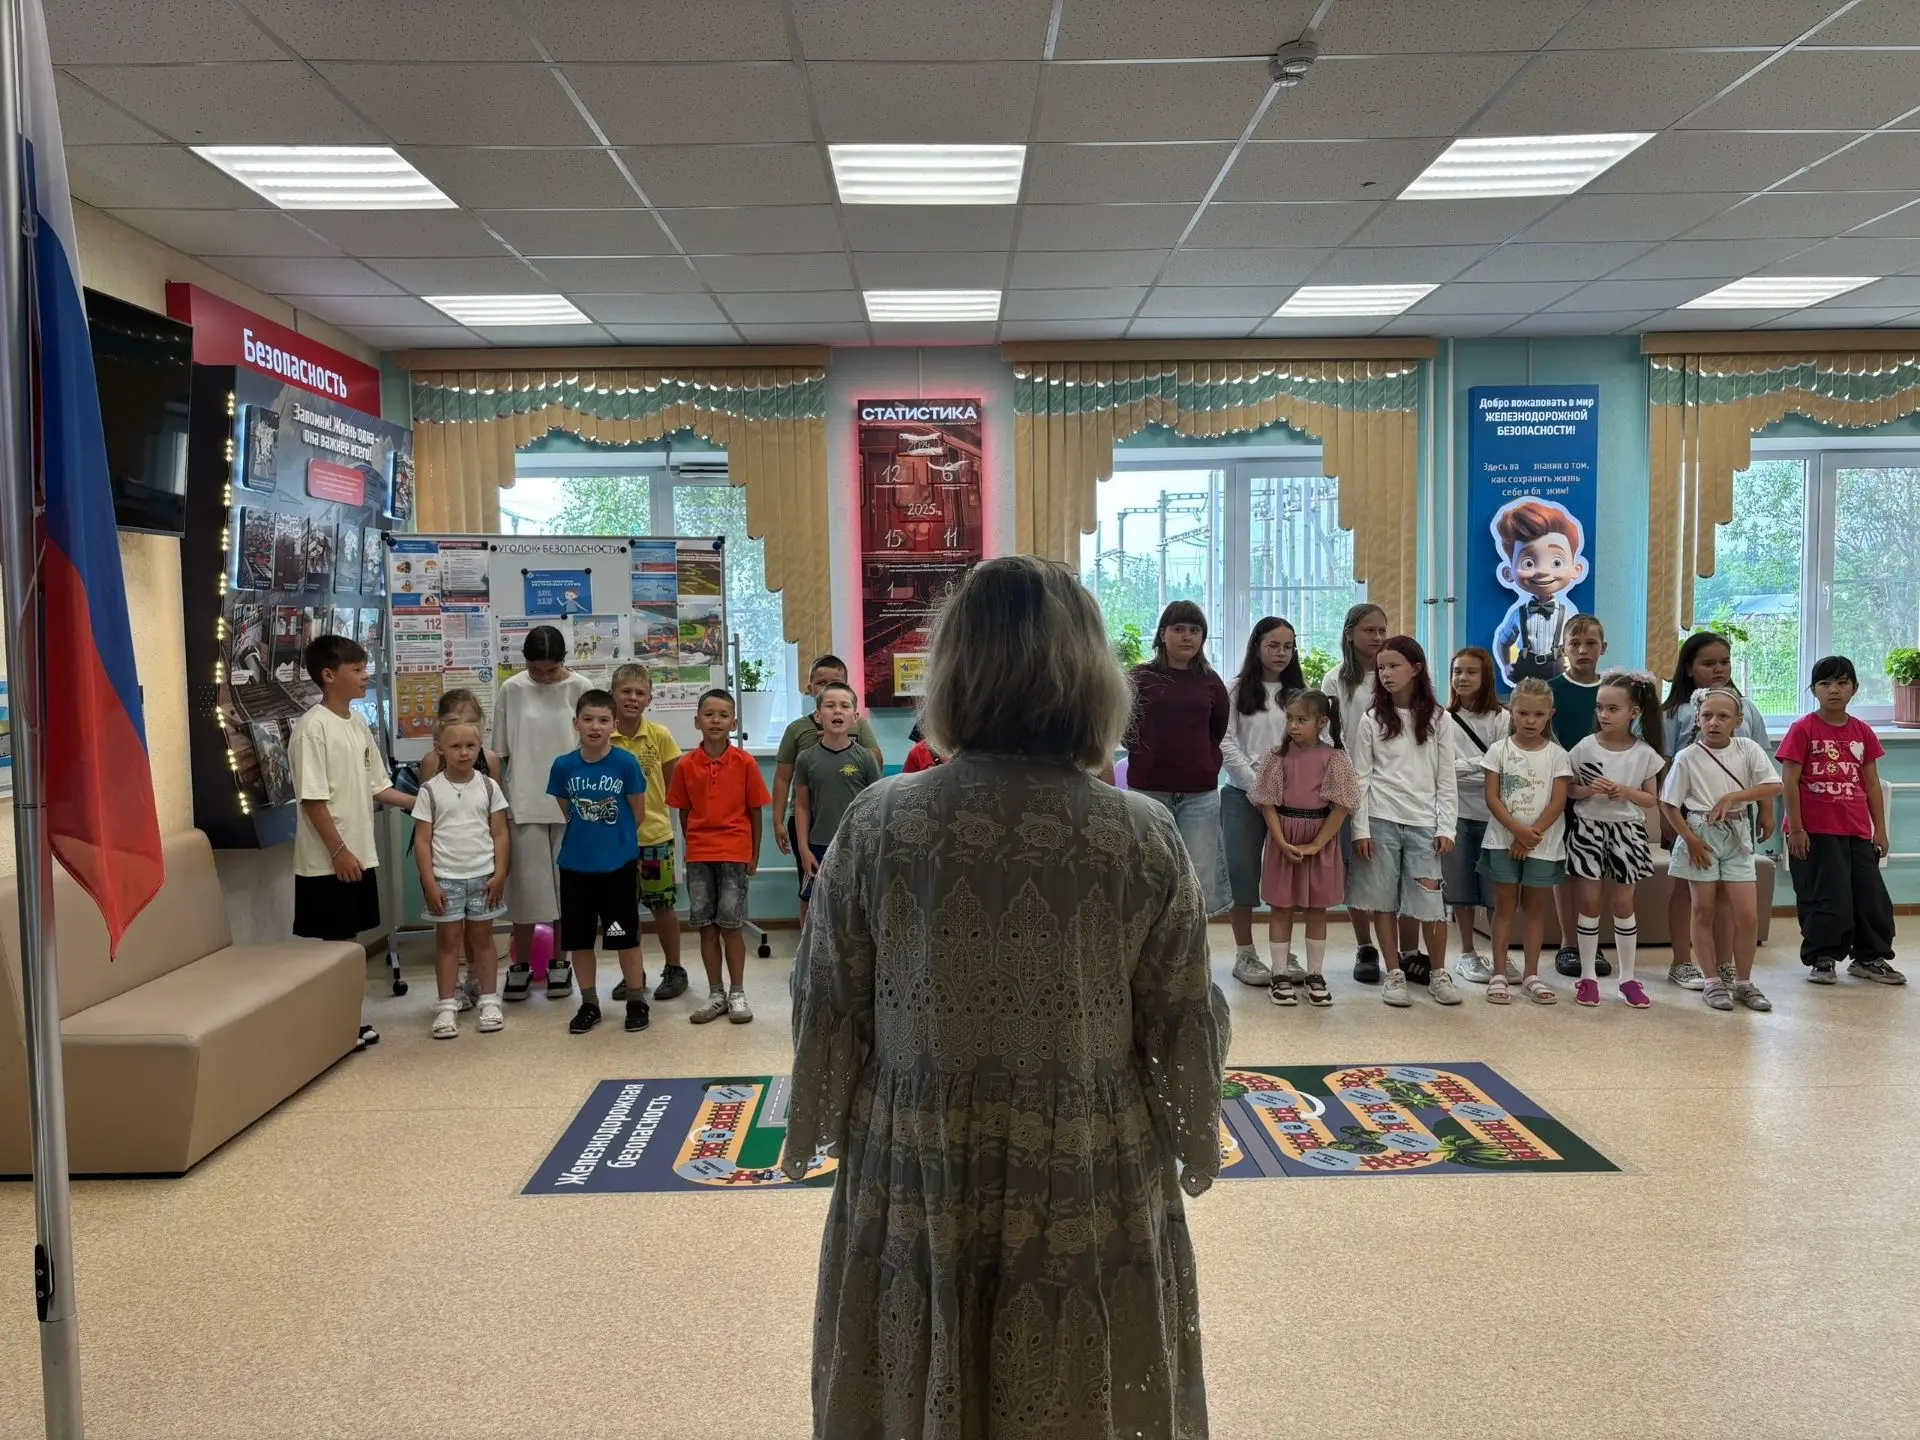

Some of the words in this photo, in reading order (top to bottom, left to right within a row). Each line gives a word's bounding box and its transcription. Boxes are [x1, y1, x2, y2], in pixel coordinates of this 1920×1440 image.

[243, 328, 348, 399] Безопасность
[1479, 398, 1509, 409] Добро
[1511, 399, 1567, 408] пожаловать
[1576, 398, 1595, 408] мир
[862, 406, 978, 420] СТАТИСТИКА
[1485, 409, 1588, 422] ЖЕЛЕЗНОДОРОЖНОЙ
[293, 403, 332, 432] Запомни!
[333, 416, 357, 436] Жизнь
[357, 428, 375, 445] одна
[1497, 425, 1576, 436] БЕЗОПАСНОСТИ!
[303, 429, 319, 445] она
[320, 435, 350, 454] важнее
[350, 443, 372, 461] всего!
[882, 464, 901, 483] 12
[942, 462, 953, 481] 6
[1483, 463, 1507, 471] Здесь
[1572, 462, 1590, 470] том,
[1508, 475, 1552, 485] сохранить
[1502, 487, 1522, 496] себе
[1531, 487, 1569, 495] блзким!
[907, 503, 937, 516] 2025
[885, 529, 902, 548] 15
[944, 527, 958, 548] 11
[498, 545, 538, 553] УГОЛОК
[542, 545, 621, 553] БЕЗОПАСНОСТИ
[887, 581, 894, 599] 1
[944, 580, 953, 598] 0
[424, 618, 442, 630] 112
[565, 776, 581, 795] HIT
[582, 777, 597, 791] the
[598, 775, 624, 795] ROAD
[554, 1083, 645, 1186] Железнодорожная
[607, 1094, 673, 1169] безопасность
